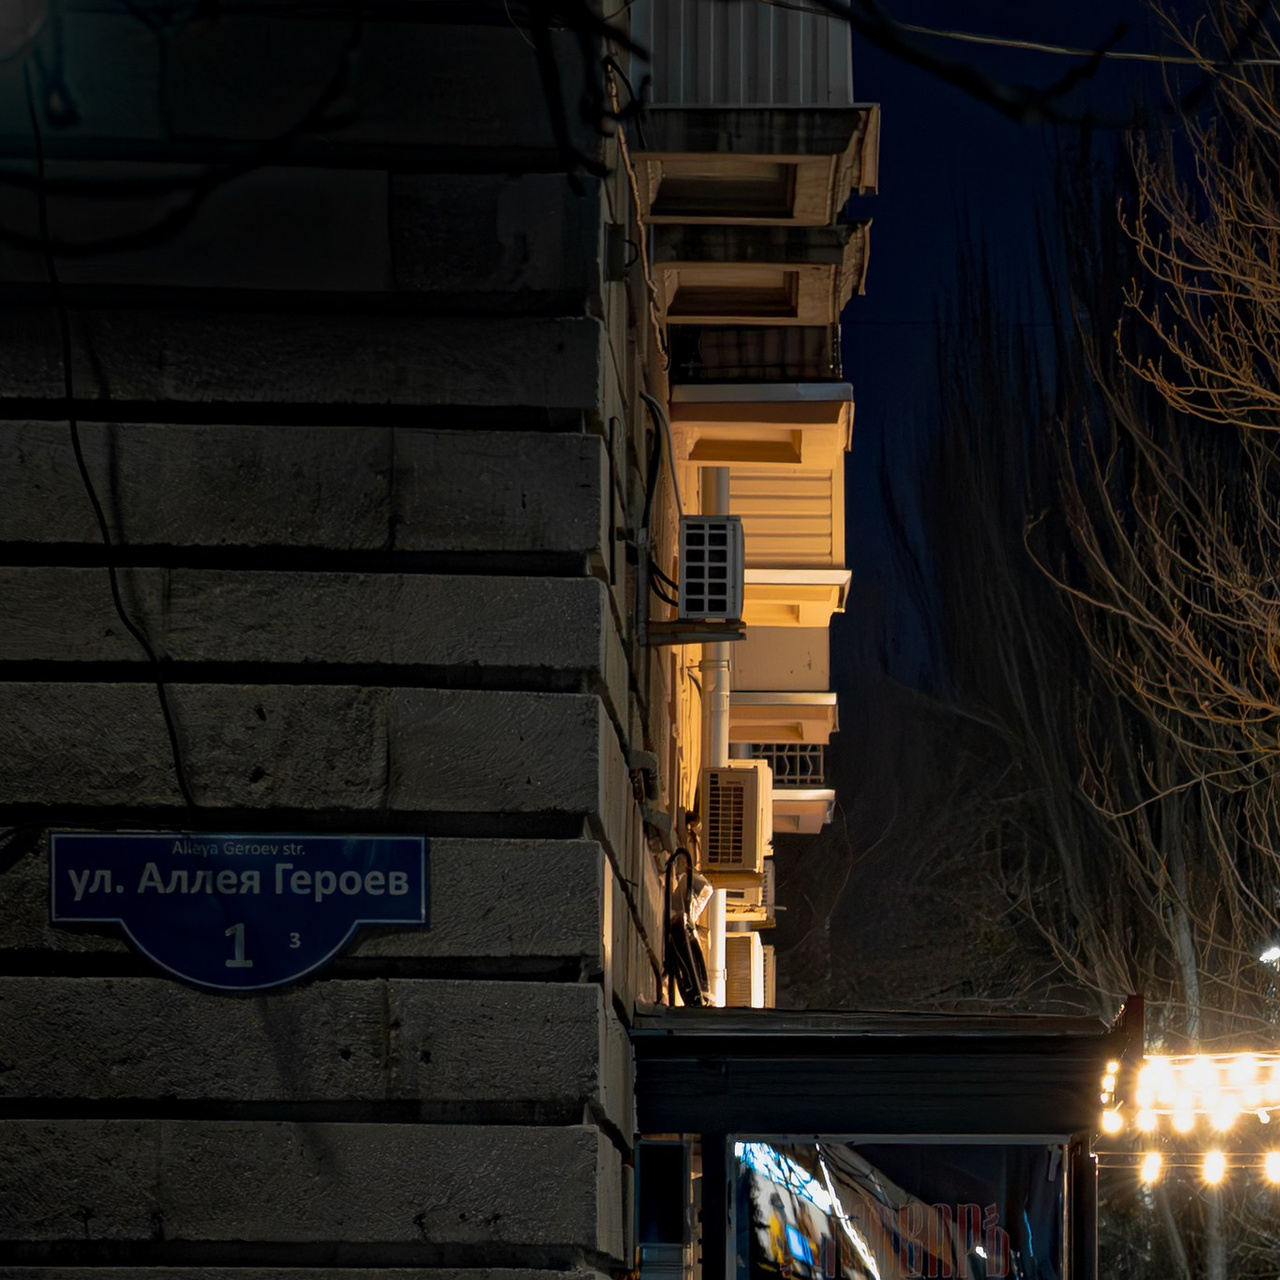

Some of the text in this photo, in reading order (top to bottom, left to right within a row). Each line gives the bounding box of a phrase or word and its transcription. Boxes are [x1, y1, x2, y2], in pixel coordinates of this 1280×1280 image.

[172, 840, 306, 857] Alleya Geroev str.
[68, 862, 409, 903] ул. Аллея Героев
[225, 922, 302, 968] 1 3
